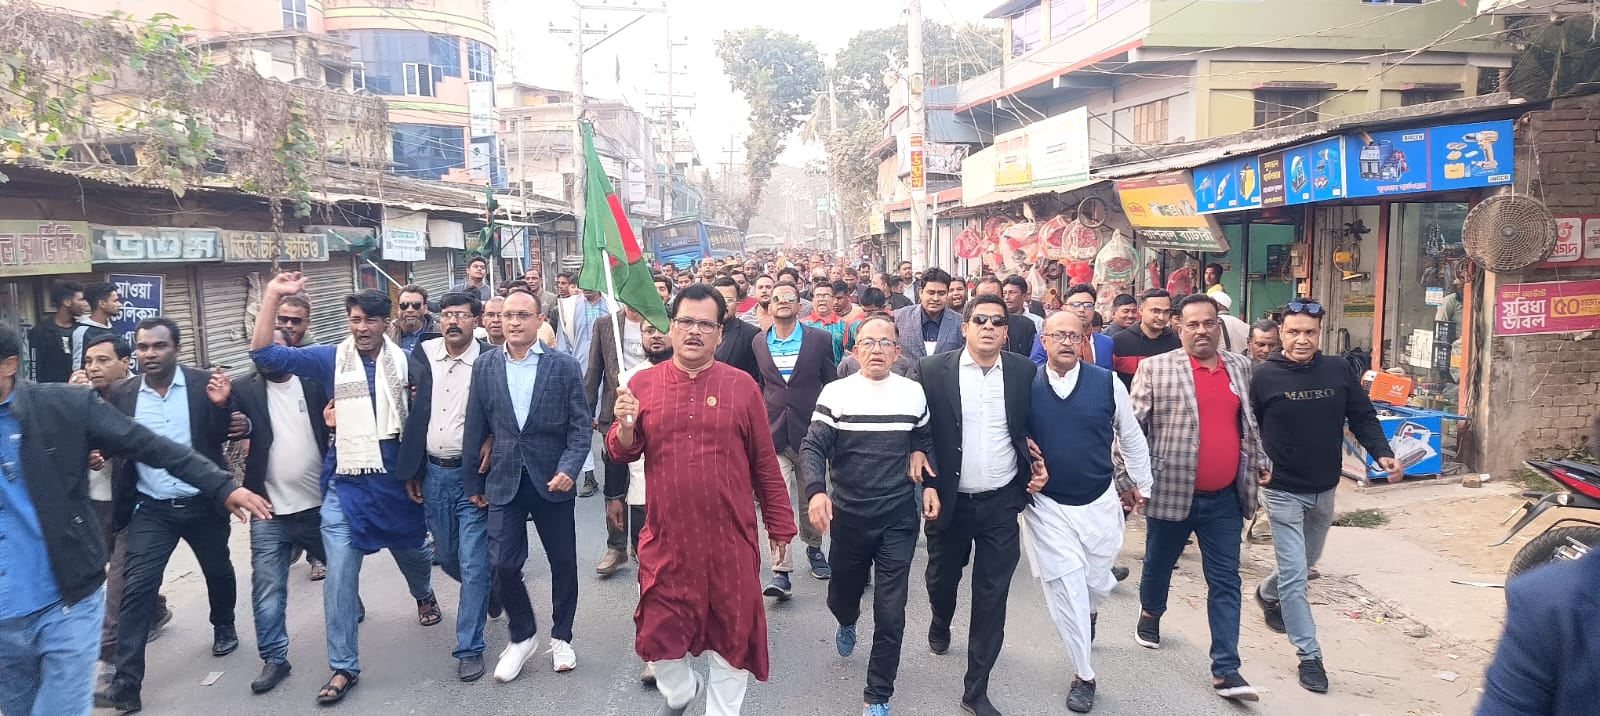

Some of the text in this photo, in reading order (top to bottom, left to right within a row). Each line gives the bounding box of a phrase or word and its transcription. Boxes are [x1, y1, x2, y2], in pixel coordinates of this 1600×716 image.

[1501, 297, 1547, 317] সুবিধা
[1553, 298, 1580, 315] ৫০
[1501, 314, 1547, 330] ডাবল
[1283, 388, 1335, 401] MAURO
